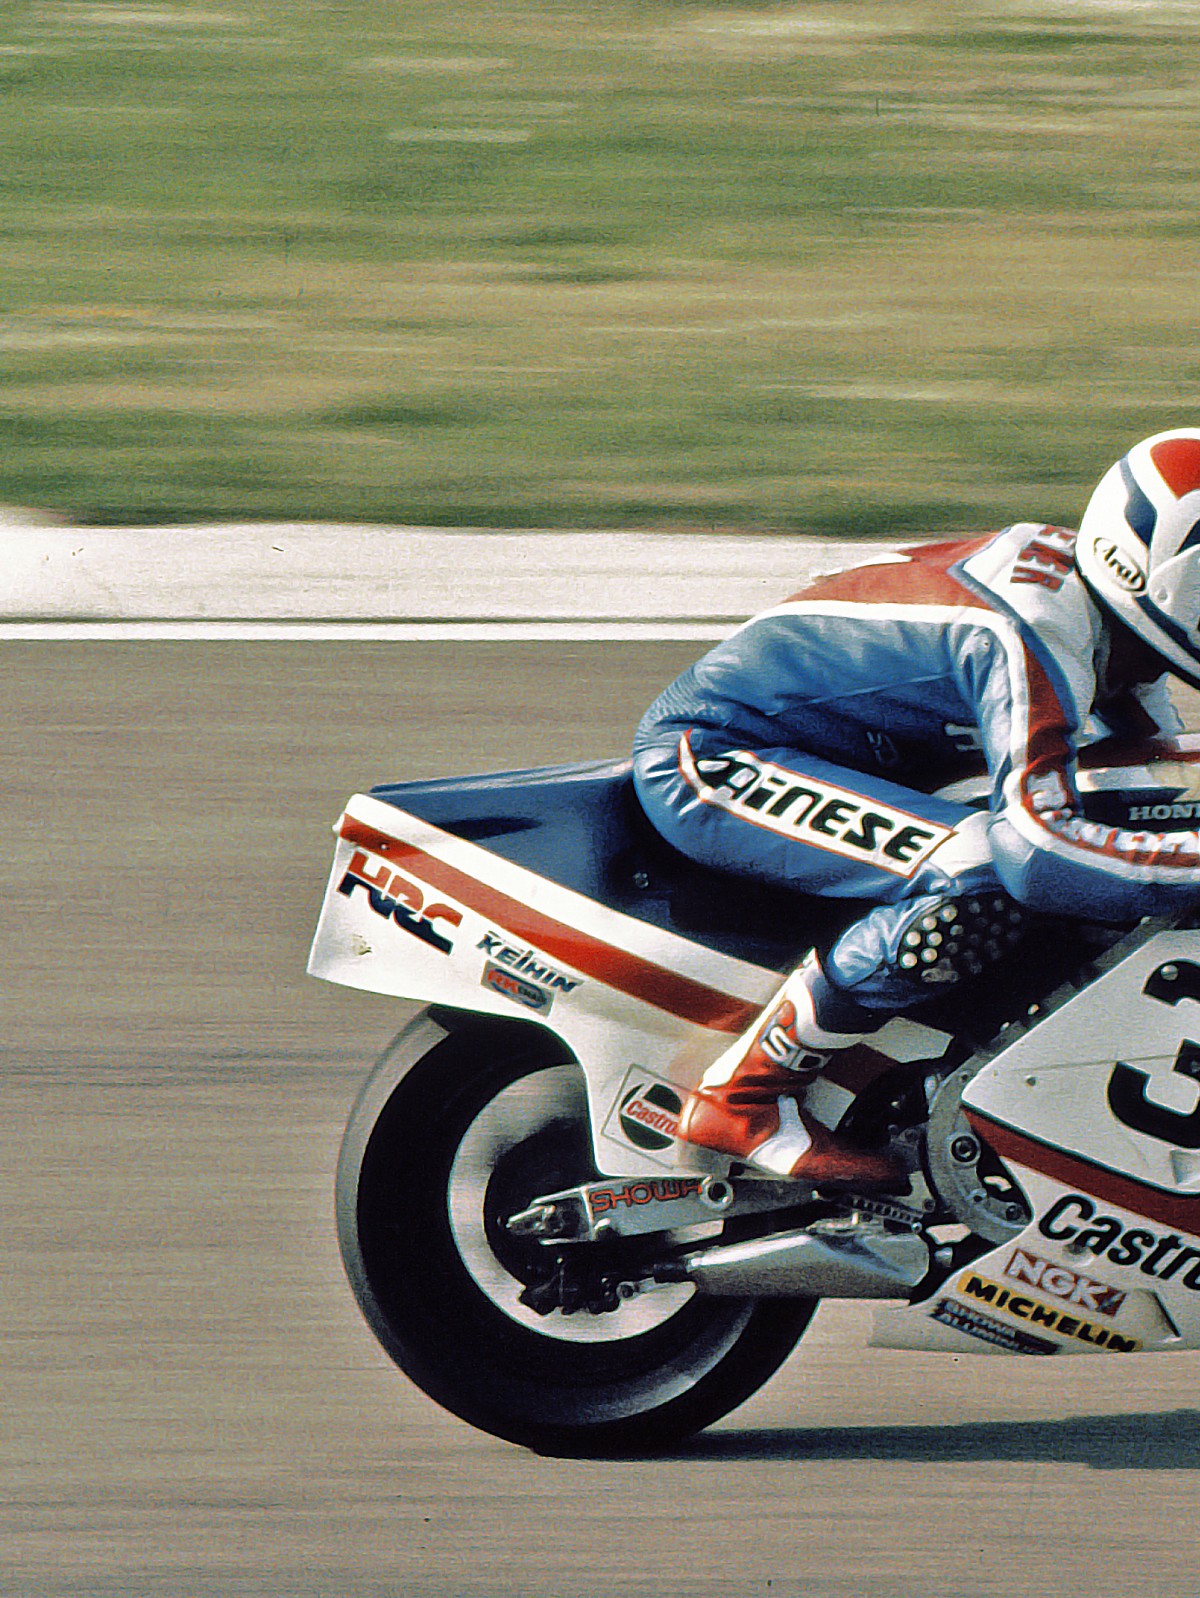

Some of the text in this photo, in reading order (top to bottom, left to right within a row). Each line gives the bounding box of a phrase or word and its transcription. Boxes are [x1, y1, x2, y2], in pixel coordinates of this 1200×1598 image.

[336, 851, 463, 956] HRC
[475, 930, 580, 992] KEIHIN
[626, 1100, 678, 1136] Castro
[590, 1180, 702, 1212] SHOWA
[1008, 1250, 1112, 1312] NGK
[964, 1276, 1140, 1353] MICHELIN
